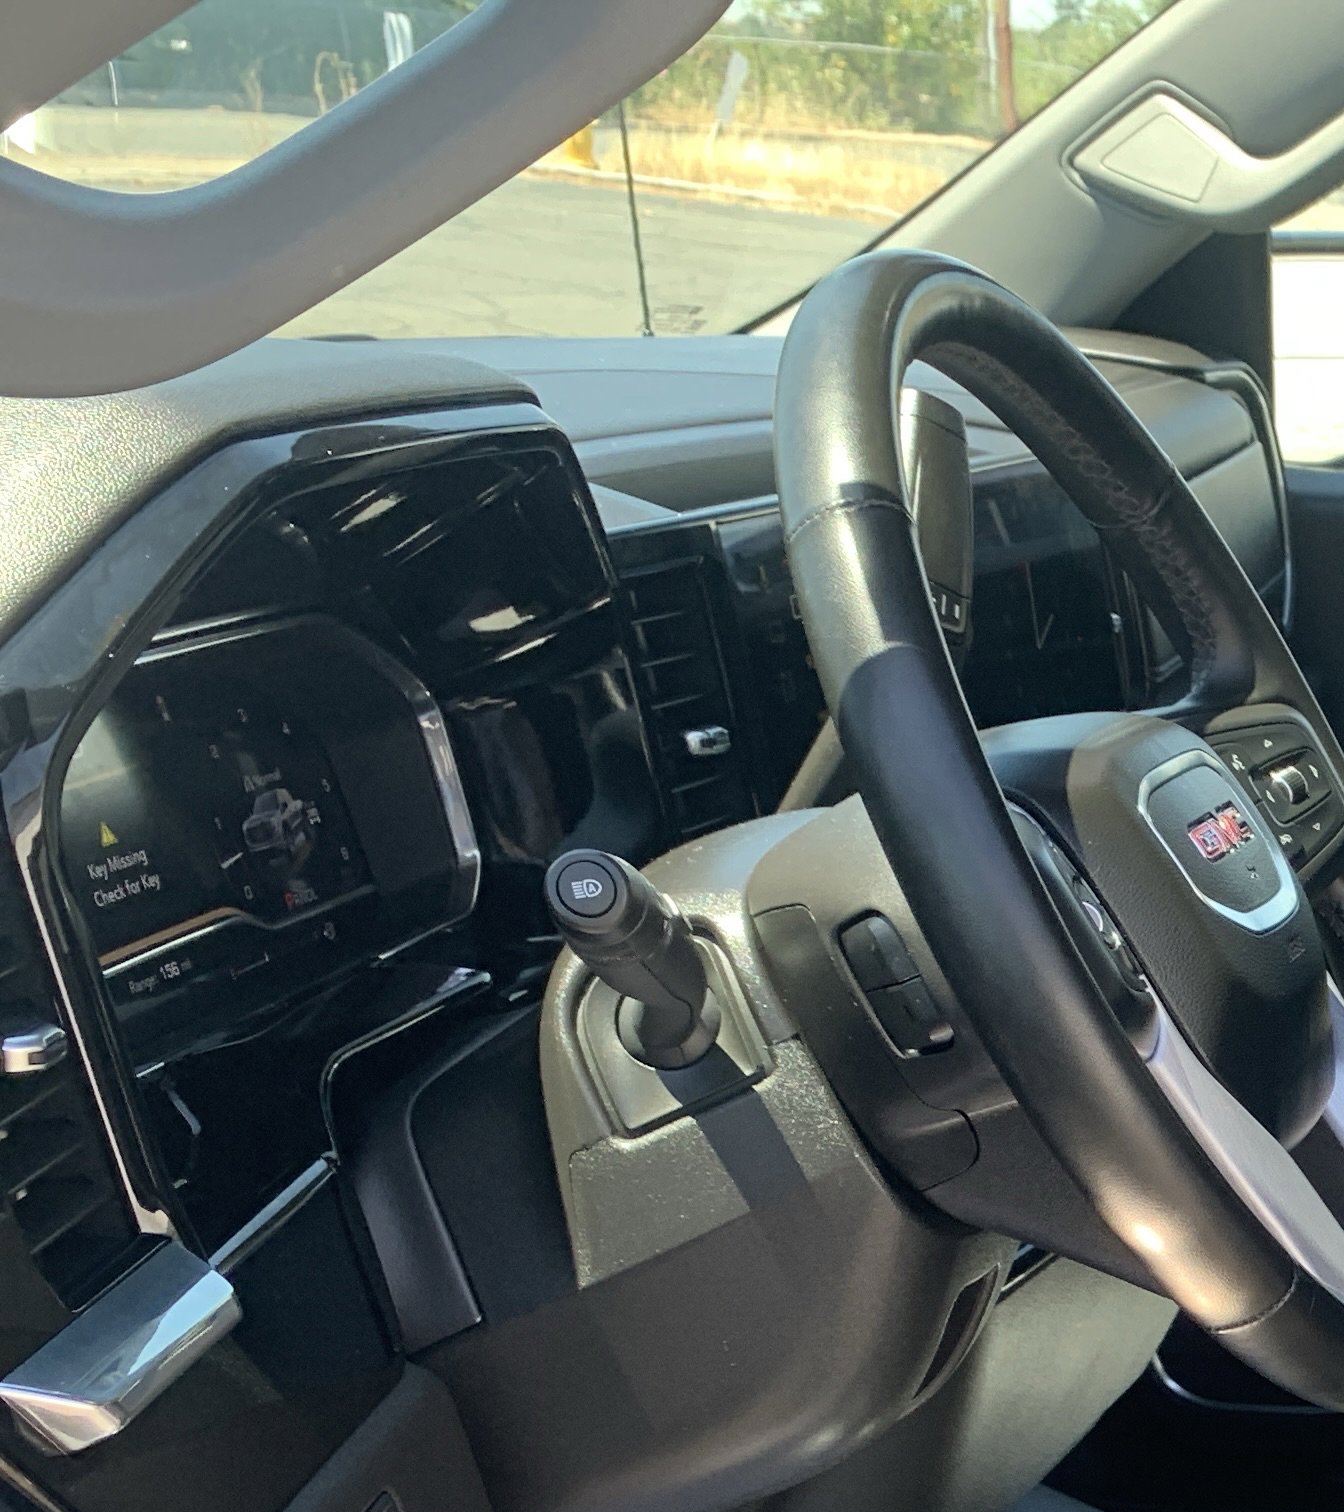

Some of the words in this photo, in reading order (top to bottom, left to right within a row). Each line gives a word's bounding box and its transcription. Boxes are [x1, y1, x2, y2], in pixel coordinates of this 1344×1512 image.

[87, 864, 109, 881] Key
[106, 849, 149, 873] Missing
[94, 884, 127, 907] Check
[124, 879, 141, 895] for
[140, 873, 160, 891] Key
[160, 961, 180, 980] 156
